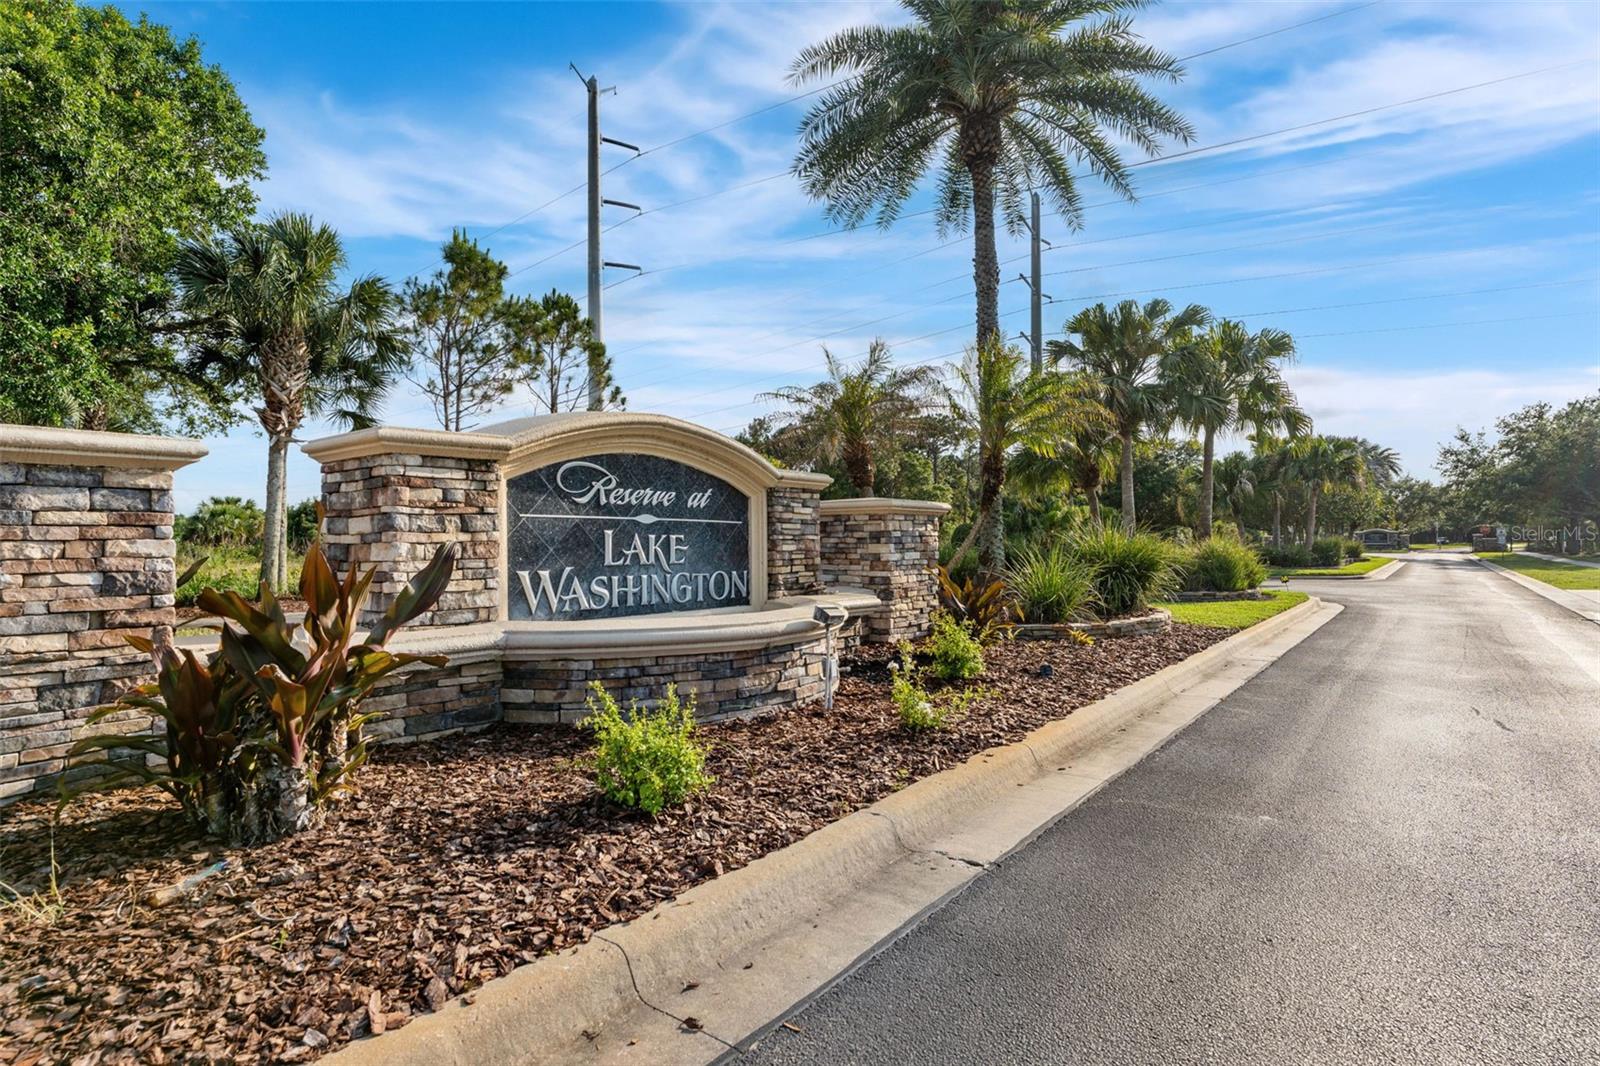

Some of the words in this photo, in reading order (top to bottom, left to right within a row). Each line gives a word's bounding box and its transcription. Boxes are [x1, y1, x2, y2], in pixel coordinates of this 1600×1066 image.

[556, 461, 676, 507] Reserve
[687, 488, 713, 509] at
[603, 529, 689, 573] LAKE
[516, 566, 748, 615] WASHINGTON
